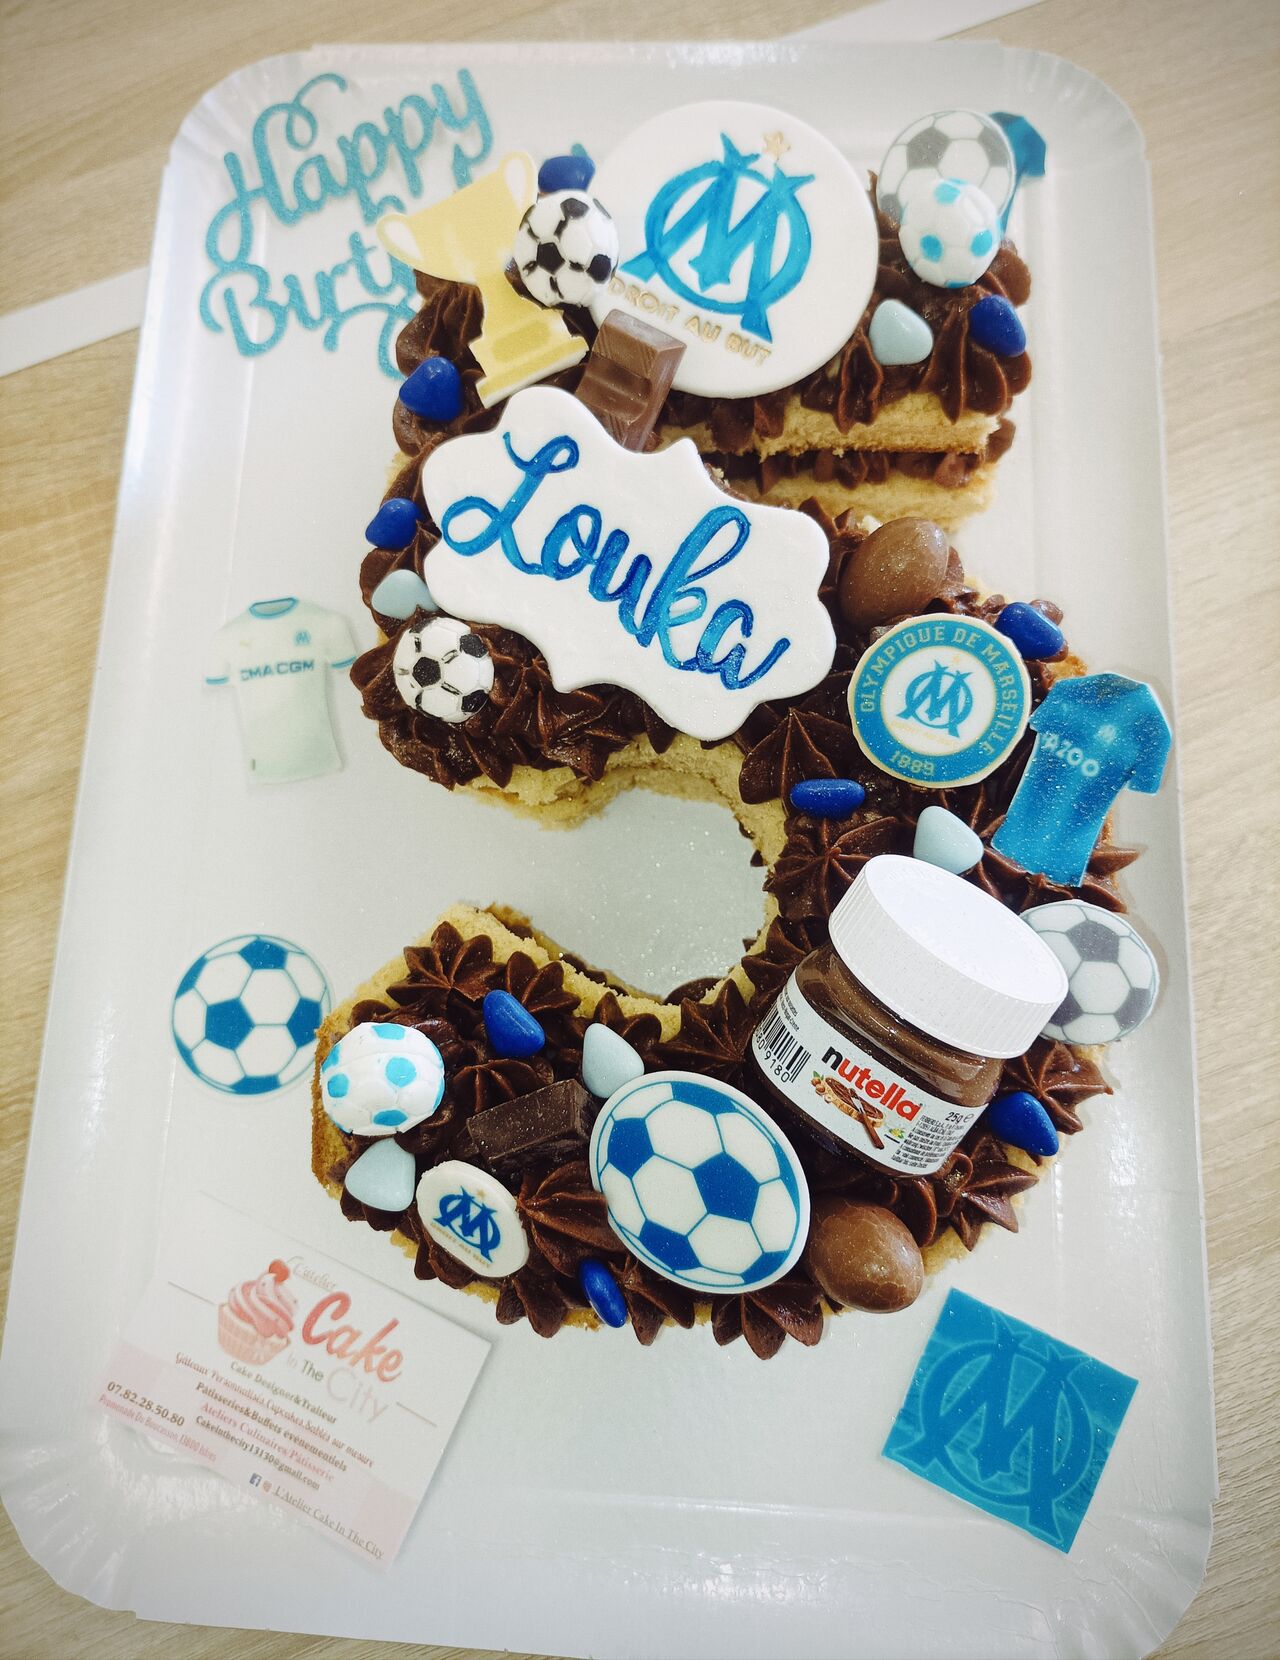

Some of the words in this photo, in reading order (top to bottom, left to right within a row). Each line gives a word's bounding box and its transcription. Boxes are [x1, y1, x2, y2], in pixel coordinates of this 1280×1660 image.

[204, 68, 494, 262] Happy
[685, 315, 721, 342] AU
[725, 331, 772, 366] BUT
[441, 432, 791, 690] Louka
[276, 659, 315, 675] CGM
[860, 626, 945, 713] OLYMPIQUE
[952, 627, 981, 648] DE
[979, 644, 1019, 755] MARSEILLE
[764, 1050, 790, 1083] 9180
[821, 1046, 921, 1122] nutella
[945, 1112, 963, 1124] 25g
[302, 1292, 404, 1383] Cake
[107, 1381, 185, 1427] 07.82.28.50.80
[301, 1360, 324, 1381] The
[327, 1366, 390, 1423] City
[313, 1508, 335, 1530] Cake
[365, 1540, 384, 1559] City
